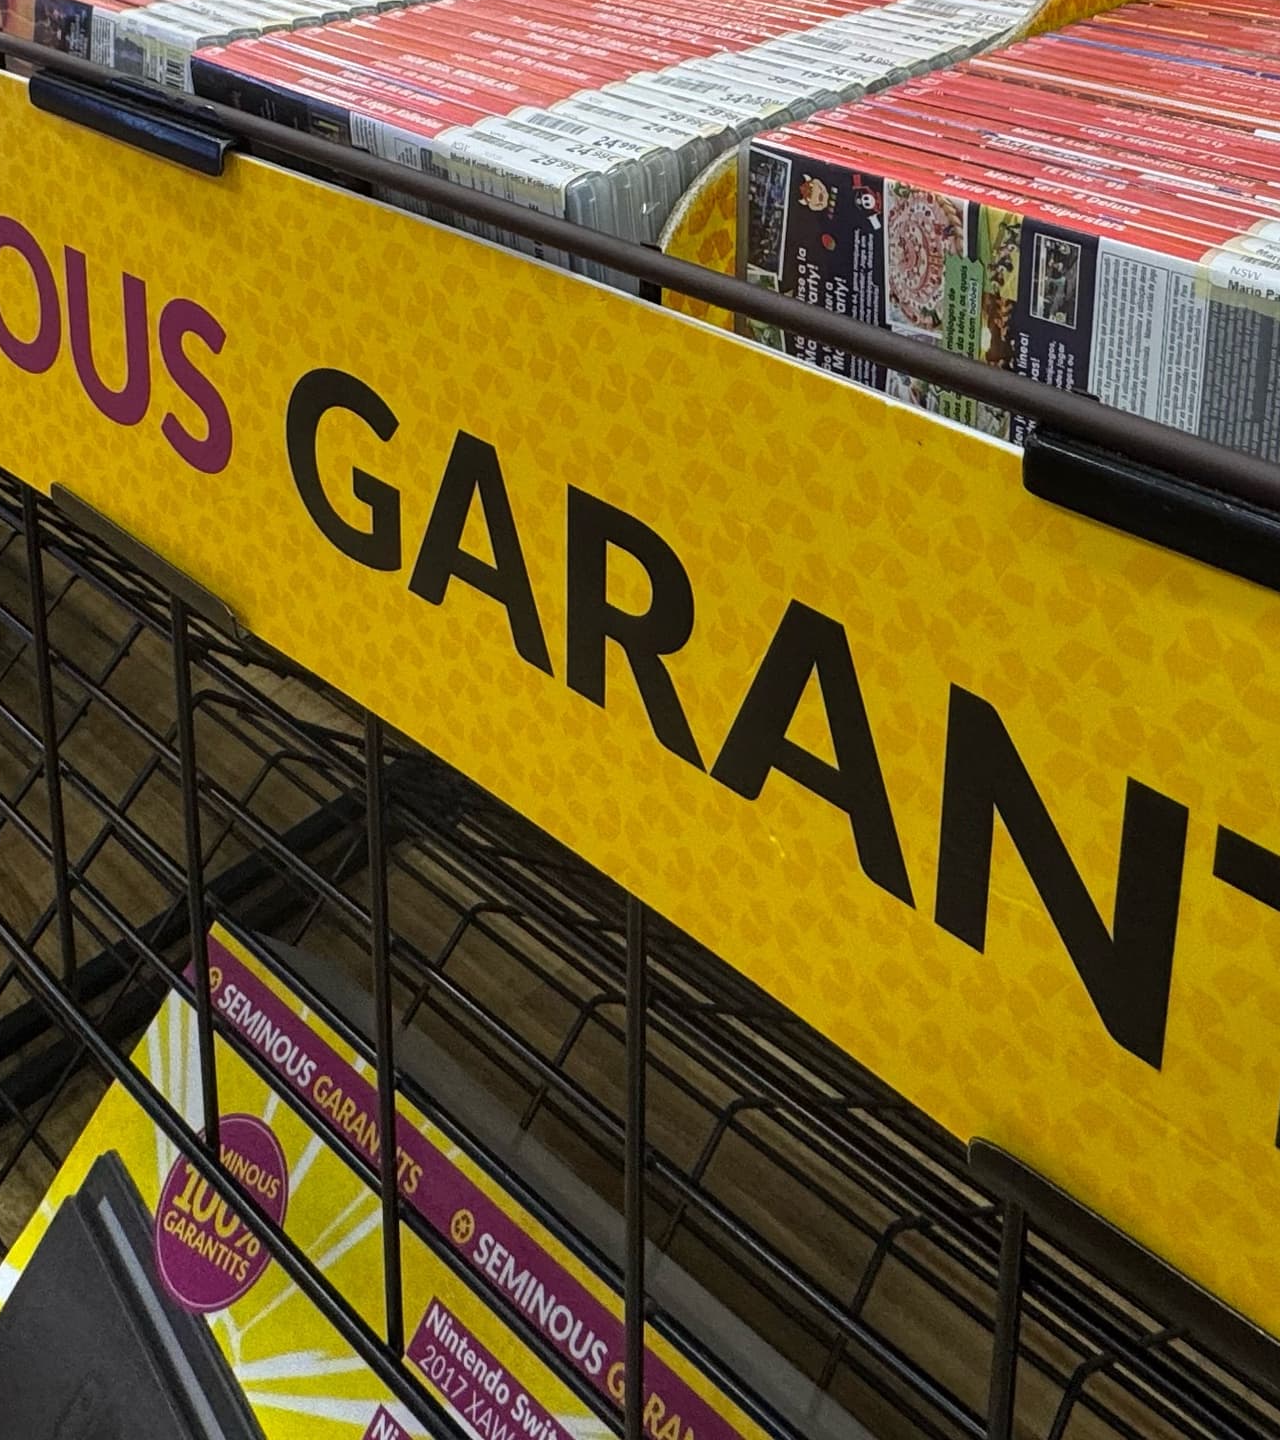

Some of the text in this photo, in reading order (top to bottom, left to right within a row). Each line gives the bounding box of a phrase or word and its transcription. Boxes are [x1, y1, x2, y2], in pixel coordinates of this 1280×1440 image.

[1227, 278, 1262, 299] Mario
[217, 983, 317, 1087] SEMINOUS
[162, 1210, 251, 1283] GARANTITS
[473, 1232, 608, 1376] SEMINOUS
[419, 1344, 469, 1402] 2017
[426, 1302, 510, 1405] Nintendo
